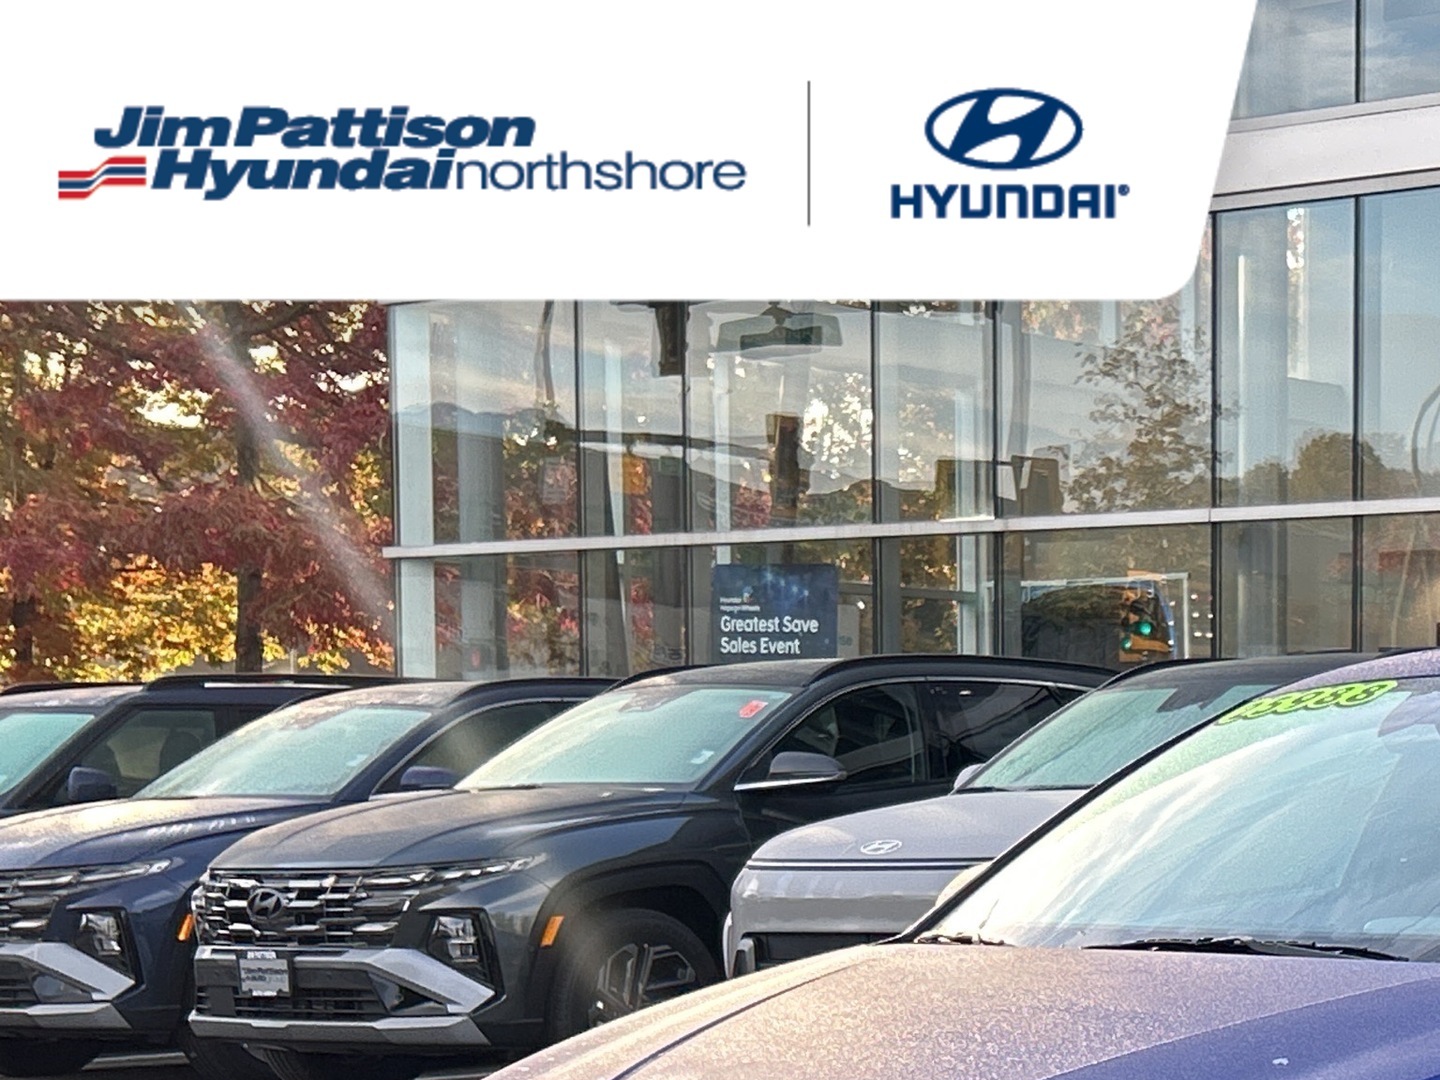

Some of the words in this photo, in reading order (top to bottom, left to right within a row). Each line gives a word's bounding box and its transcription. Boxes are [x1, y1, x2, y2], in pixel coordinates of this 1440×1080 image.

[720, 615, 779, 632] Greatest
[782, 615, 819, 633] Save
[720, 637, 757, 653] Sales
[760, 637, 801, 654] Event
